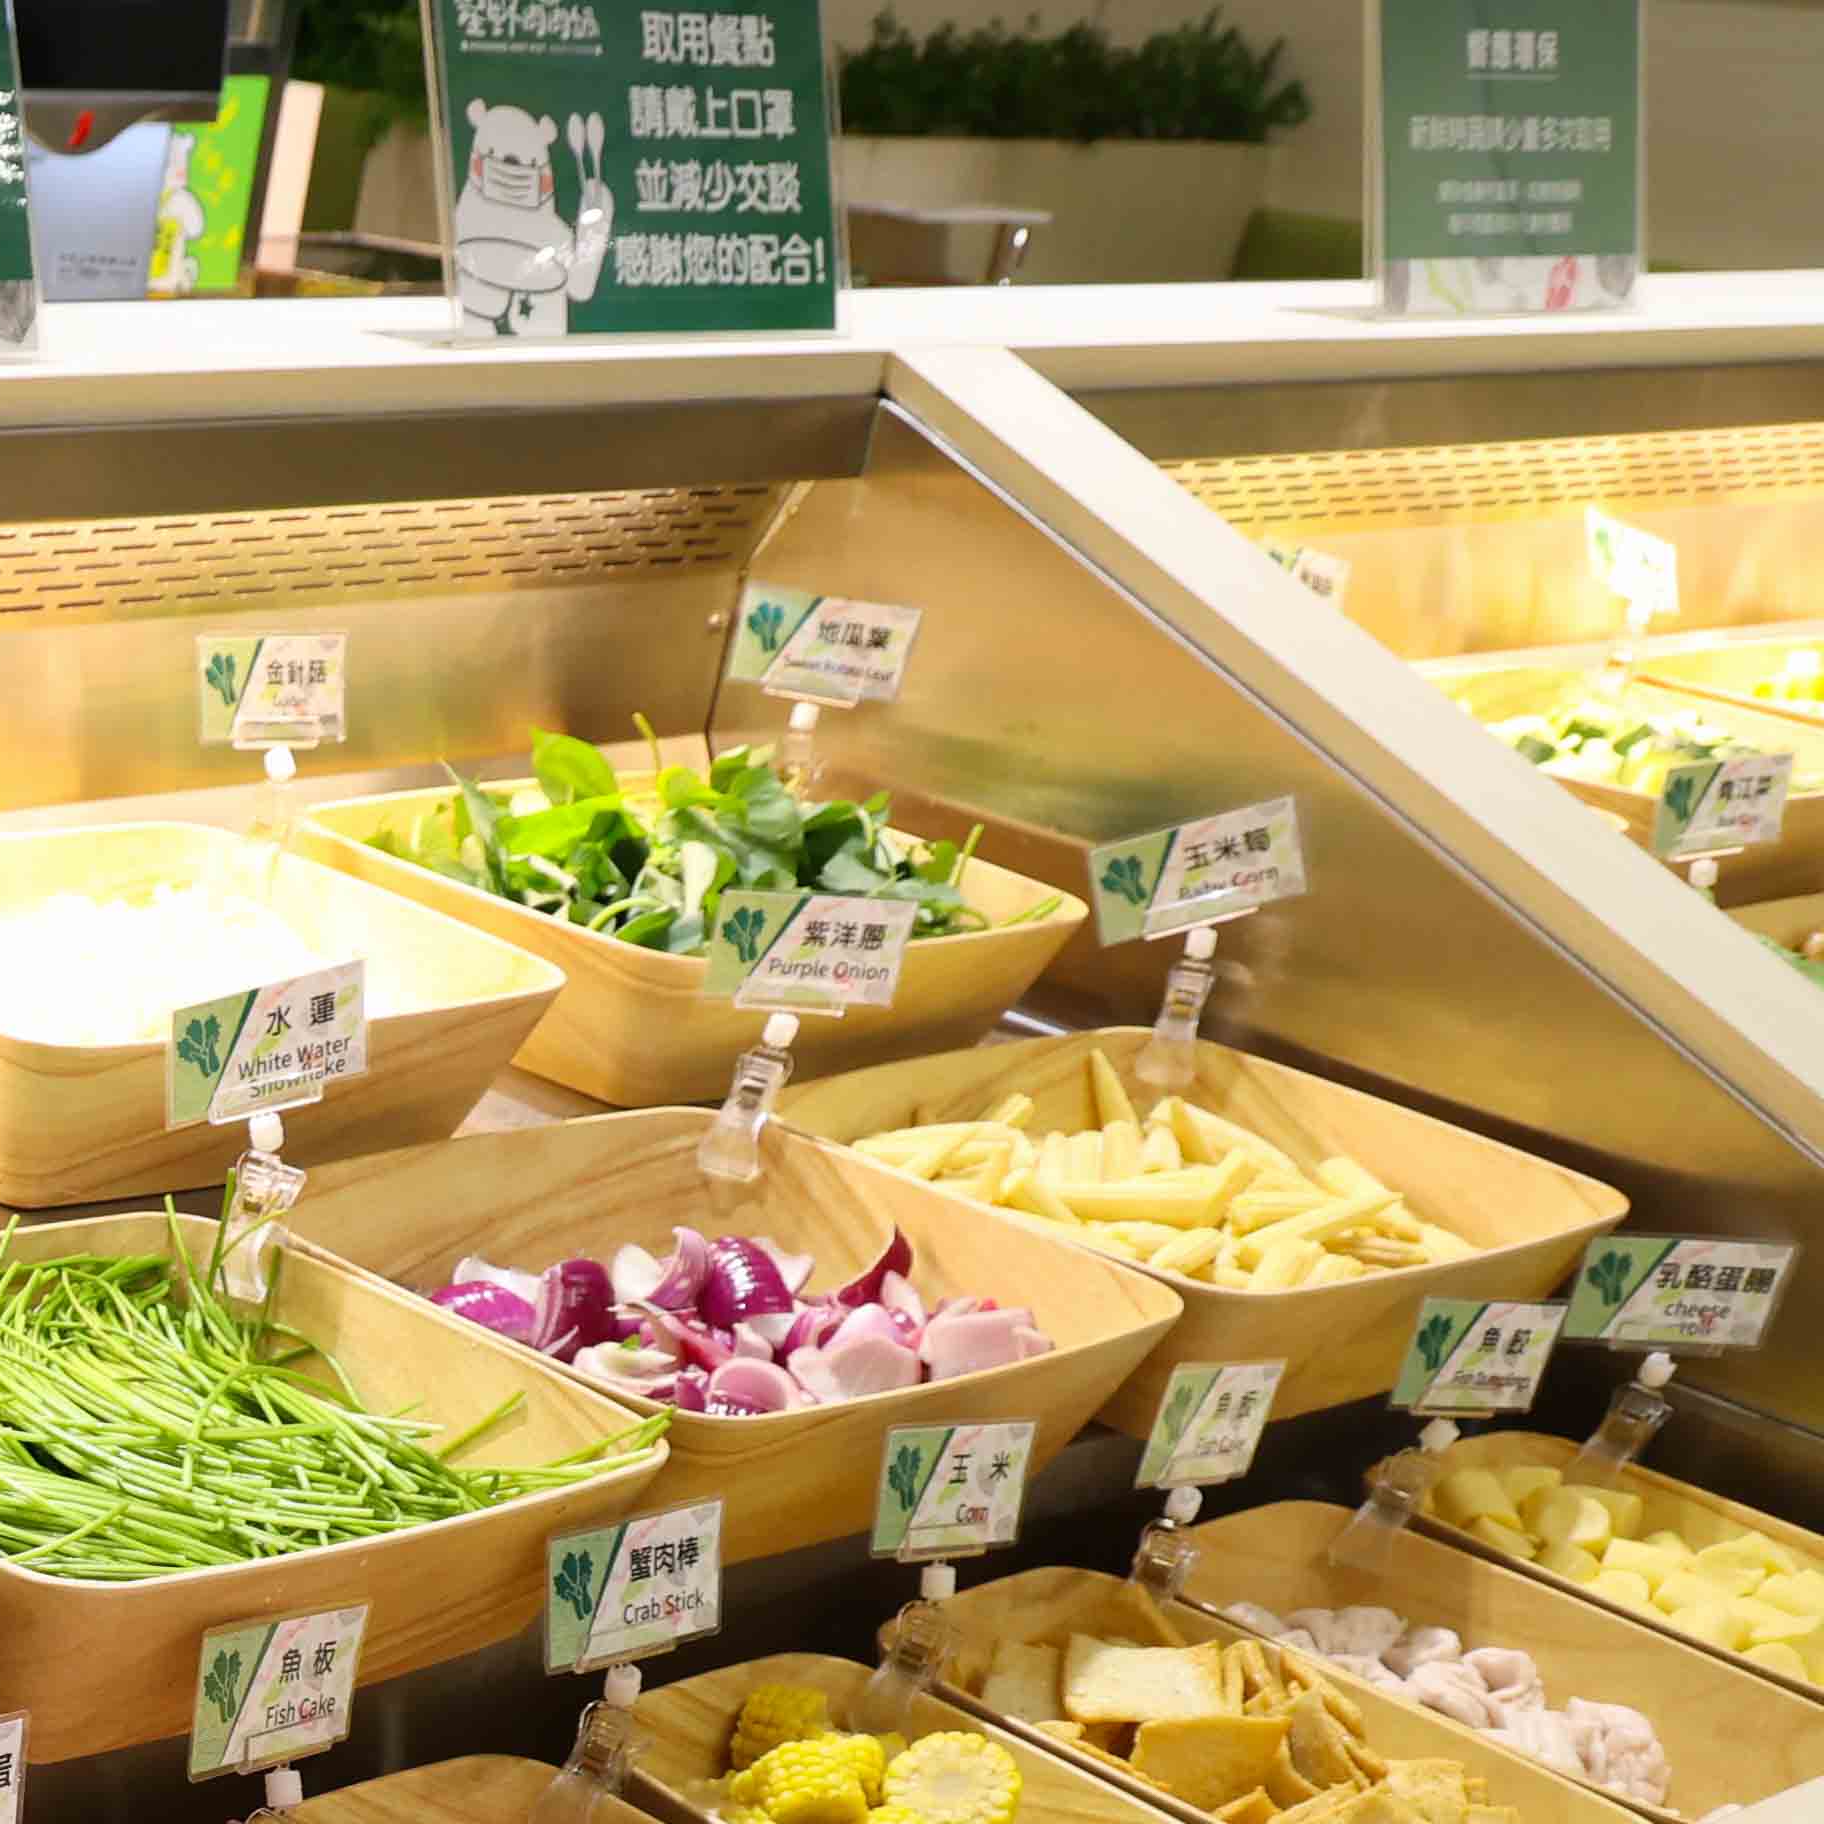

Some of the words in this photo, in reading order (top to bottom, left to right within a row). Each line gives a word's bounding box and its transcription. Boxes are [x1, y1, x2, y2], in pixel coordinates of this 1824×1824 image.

[640, 11, 775, 66] 取用餐點
[628, 84, 796, 140] 請戴上口罩
[634, 158, 802, 214] 並減少交談
[768, 957, 832, 980] Purple
[832, 960, 890, 982] Onion
[238, 1051, 292, 1081] White
[296, 1035, 352, 1064] Water
[948, 1450, 1011, 1485] 玉米
[630, 1535, 701, 1583] 蟹肉棒
[623, 1597, 661, 1625] Crab
[663, 1586, 705, 1616] Stick
[278, 1640, 337, 1685] 魚板
[265, 1703, 296, 1729] Fish
[299, 1693, 337, 1720] Cake
